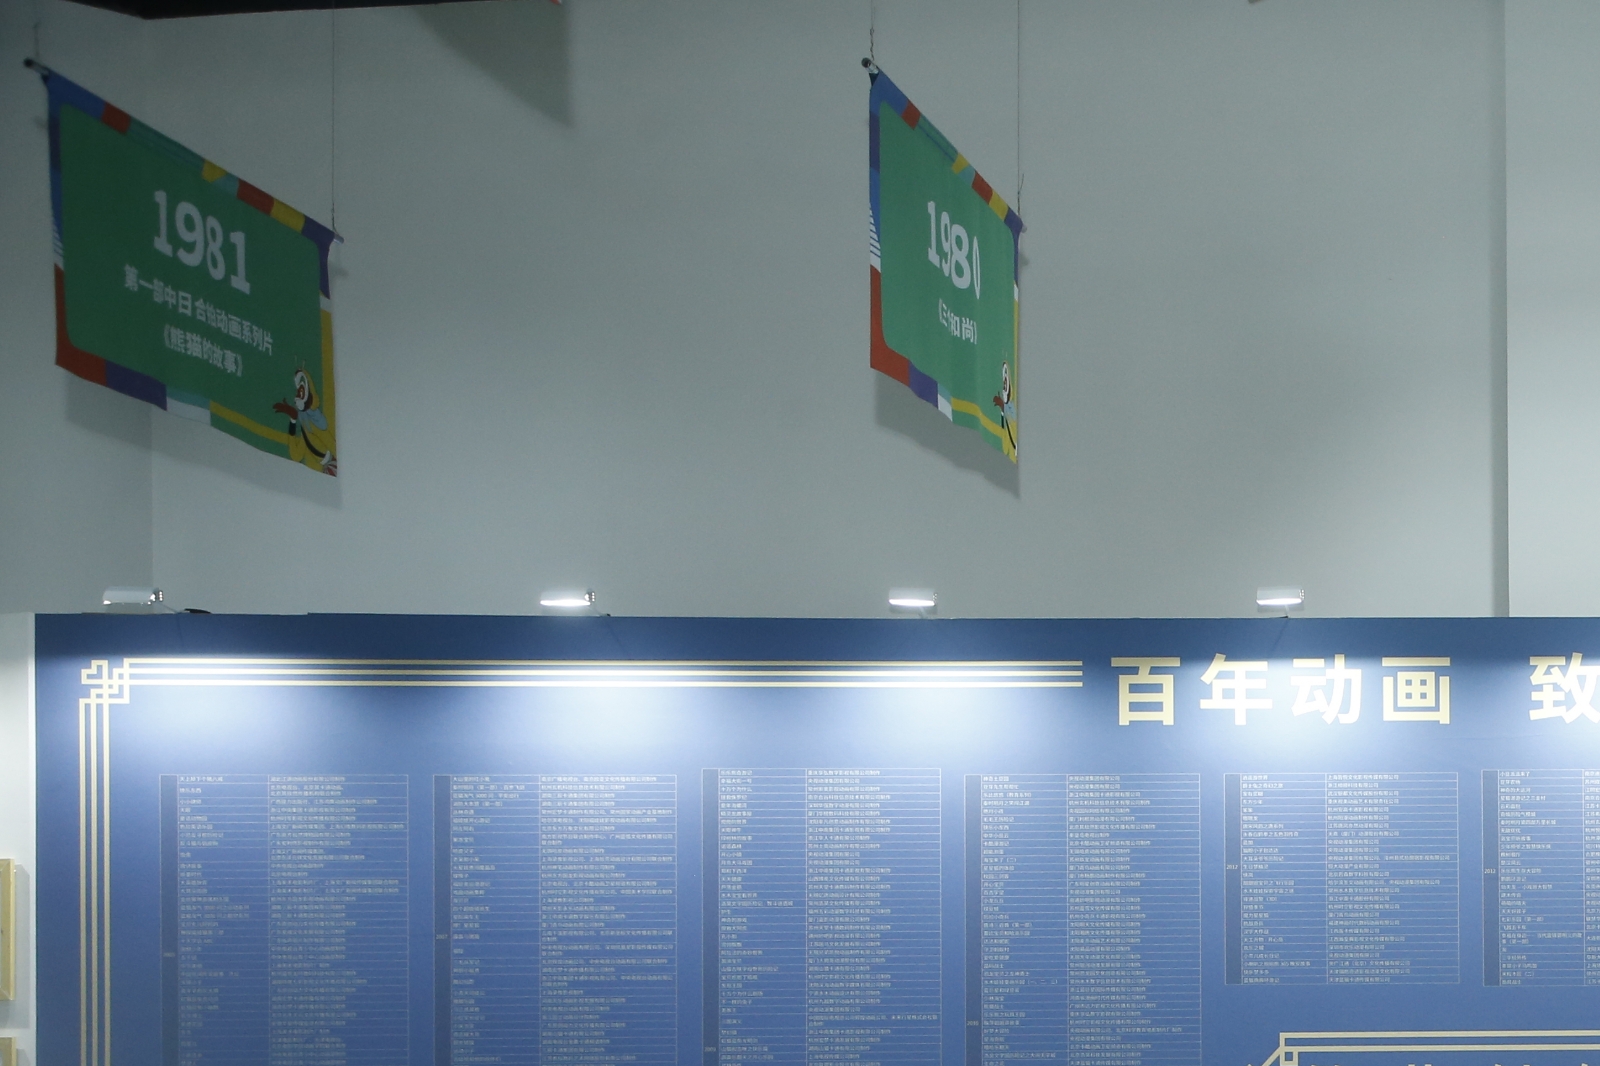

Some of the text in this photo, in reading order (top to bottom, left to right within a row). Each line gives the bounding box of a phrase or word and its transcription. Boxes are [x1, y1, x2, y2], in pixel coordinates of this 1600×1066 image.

[153, 189, 251, 295] 1981
[927, 200, 981, 300] 1980
[1110, 652, 1452, 726] 百年动画
